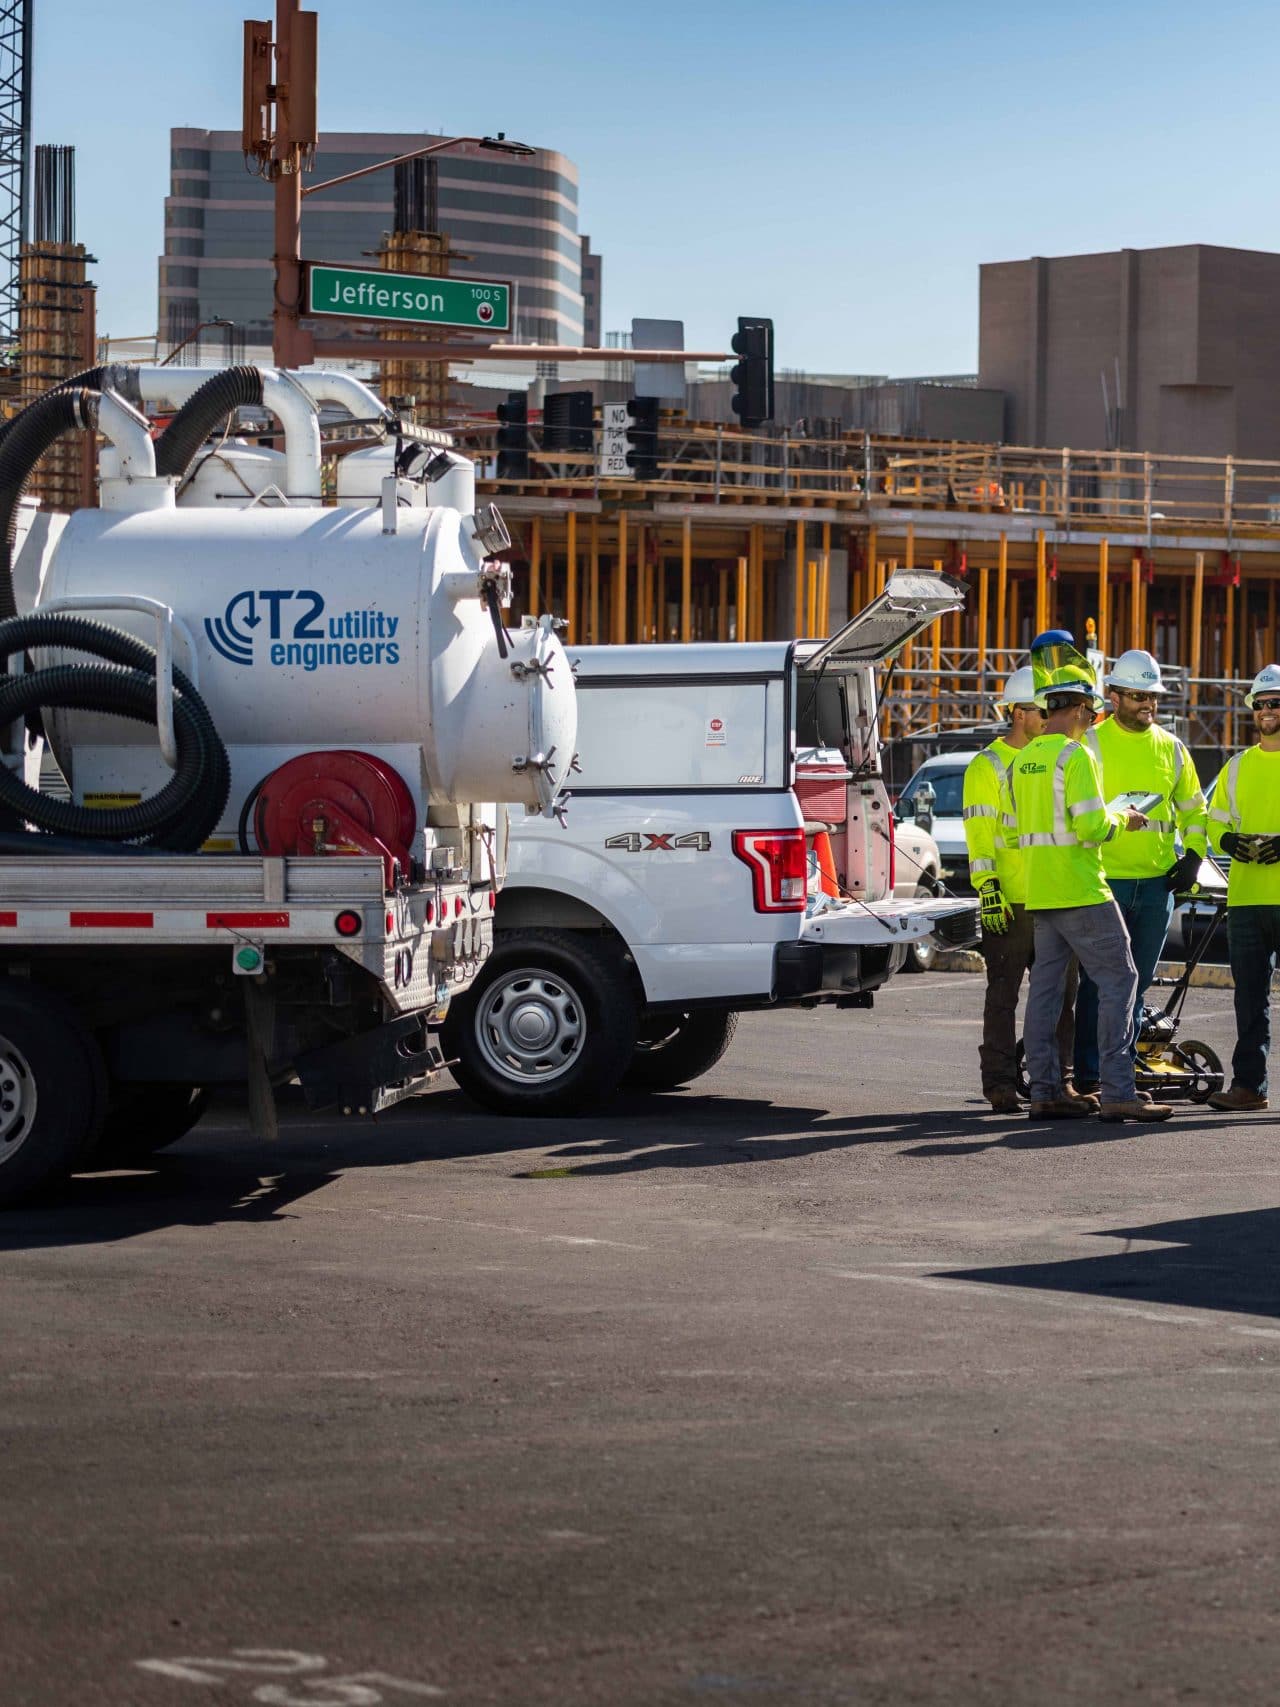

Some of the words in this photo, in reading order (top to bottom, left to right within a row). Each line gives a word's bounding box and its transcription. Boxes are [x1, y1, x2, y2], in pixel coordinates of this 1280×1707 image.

[329, 280, 444, 312] Jefferson
[471, 288, 491, 300] 100
[494, 290, 500, 301] S
[612, 409, 625, 423] NO
[611, 443, 623, 455] ON
[608, 458, 625, 470] RED
[258, 590, 325, 639] T2
[329, 610, 399, 639] utility
[270, 641, 400, 672] engineers
